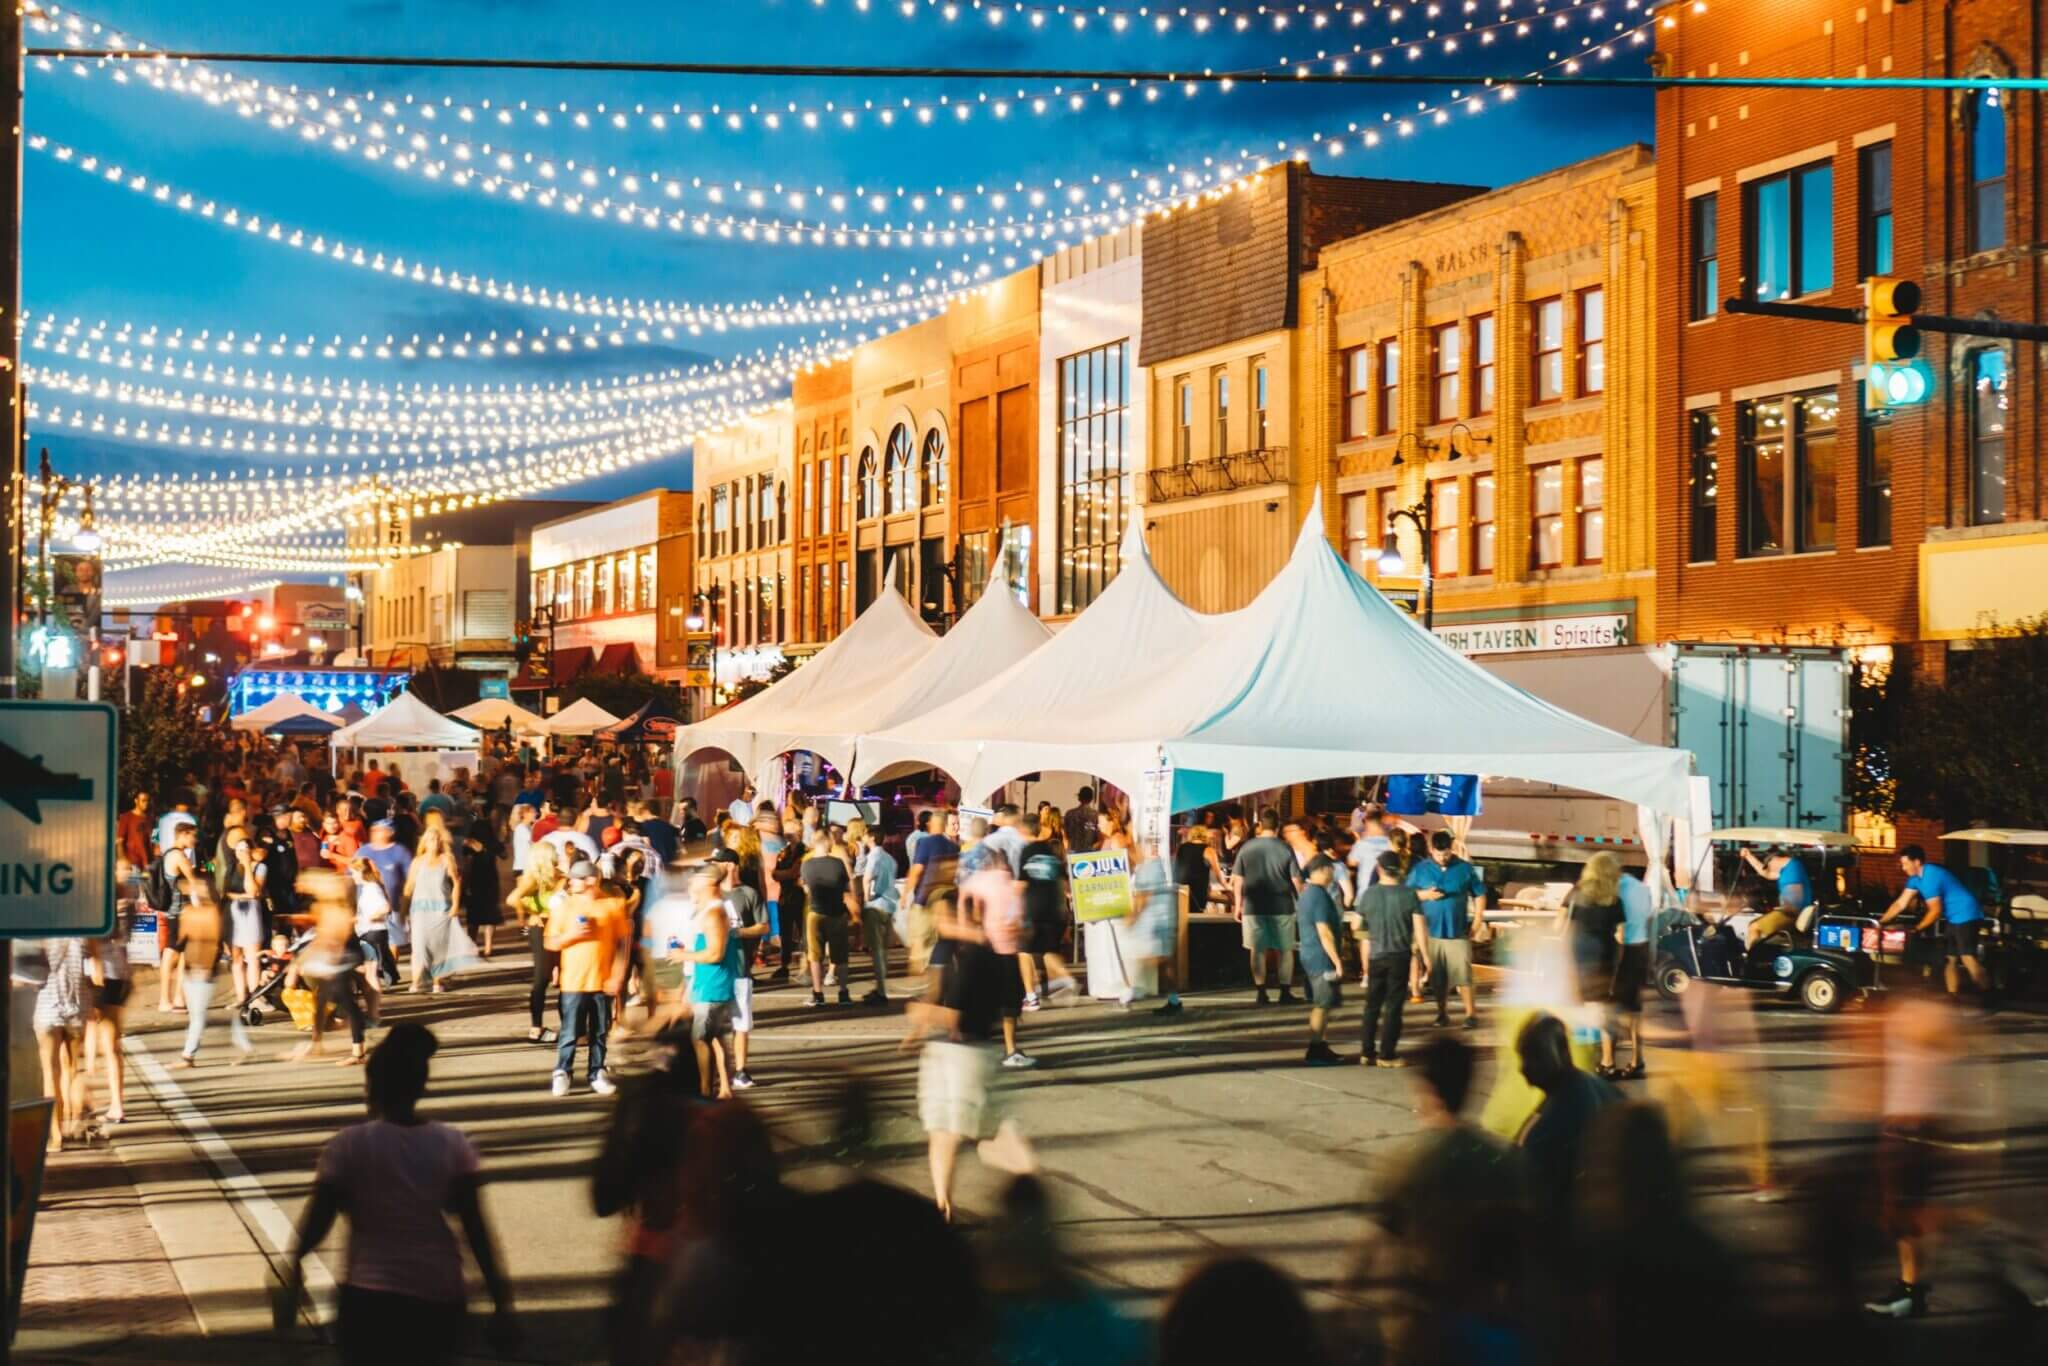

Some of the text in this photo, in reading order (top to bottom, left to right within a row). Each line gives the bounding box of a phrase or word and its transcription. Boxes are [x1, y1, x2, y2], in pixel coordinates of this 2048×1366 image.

[1435, 242, 1488, 272] WALSH
[1473, 628, 1537, 649] TAVERN
[1554, 624, 1611, 649] Spirits
[1096, 855, 1127, 873] JULY
[1, 863, 73, 895] ING
